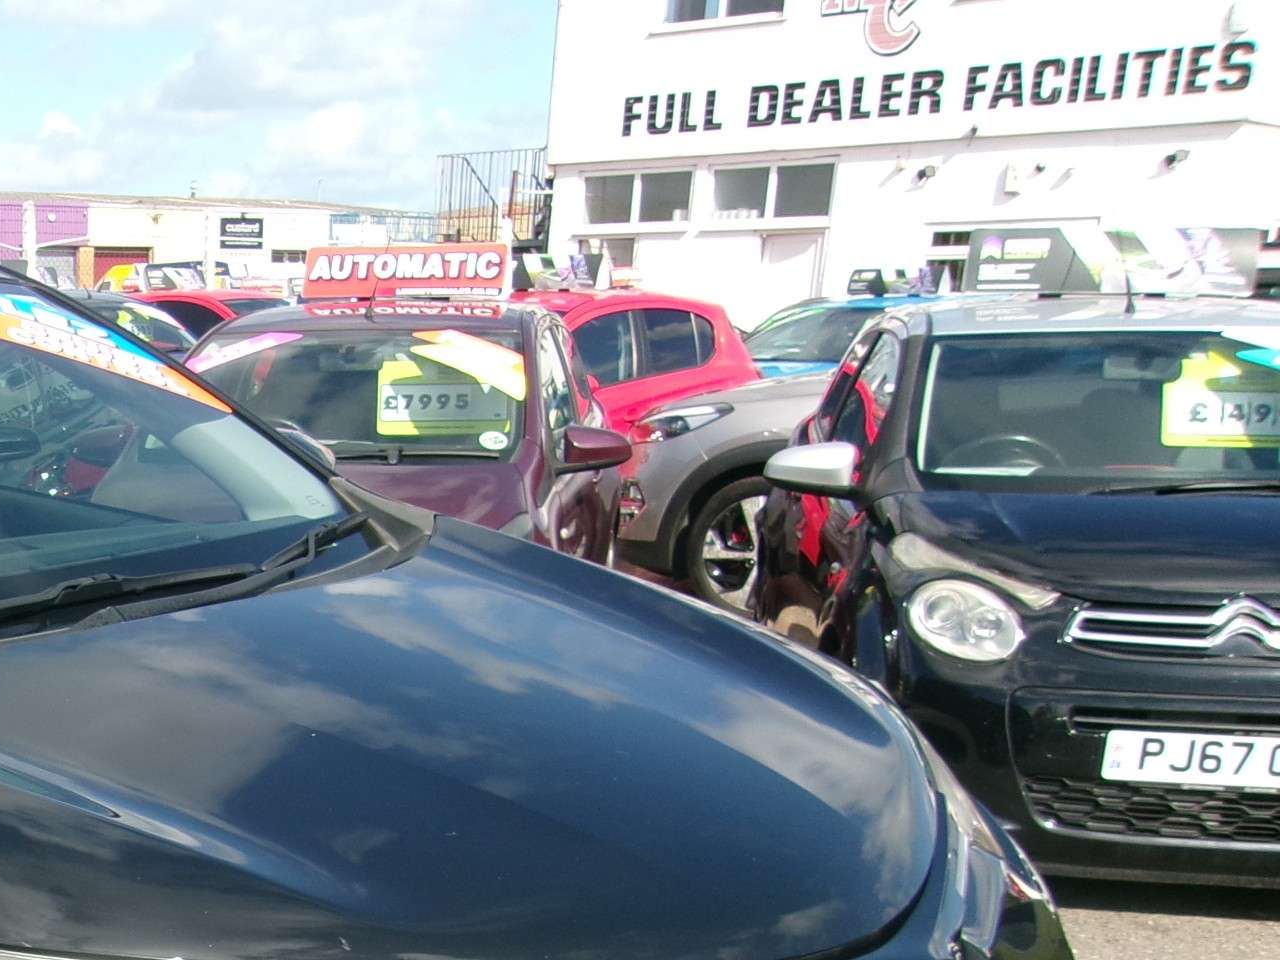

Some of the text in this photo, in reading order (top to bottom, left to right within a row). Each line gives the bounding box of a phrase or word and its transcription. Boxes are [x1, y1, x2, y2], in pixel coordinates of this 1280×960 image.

[622, 41, 1258, 137] FULL DEALER FACILITIES
[309, 252, 502, 281] AUTOMATIC
[383, 393, 469, 411] £7995
[1137, 737, 1255, 775] PJ67
